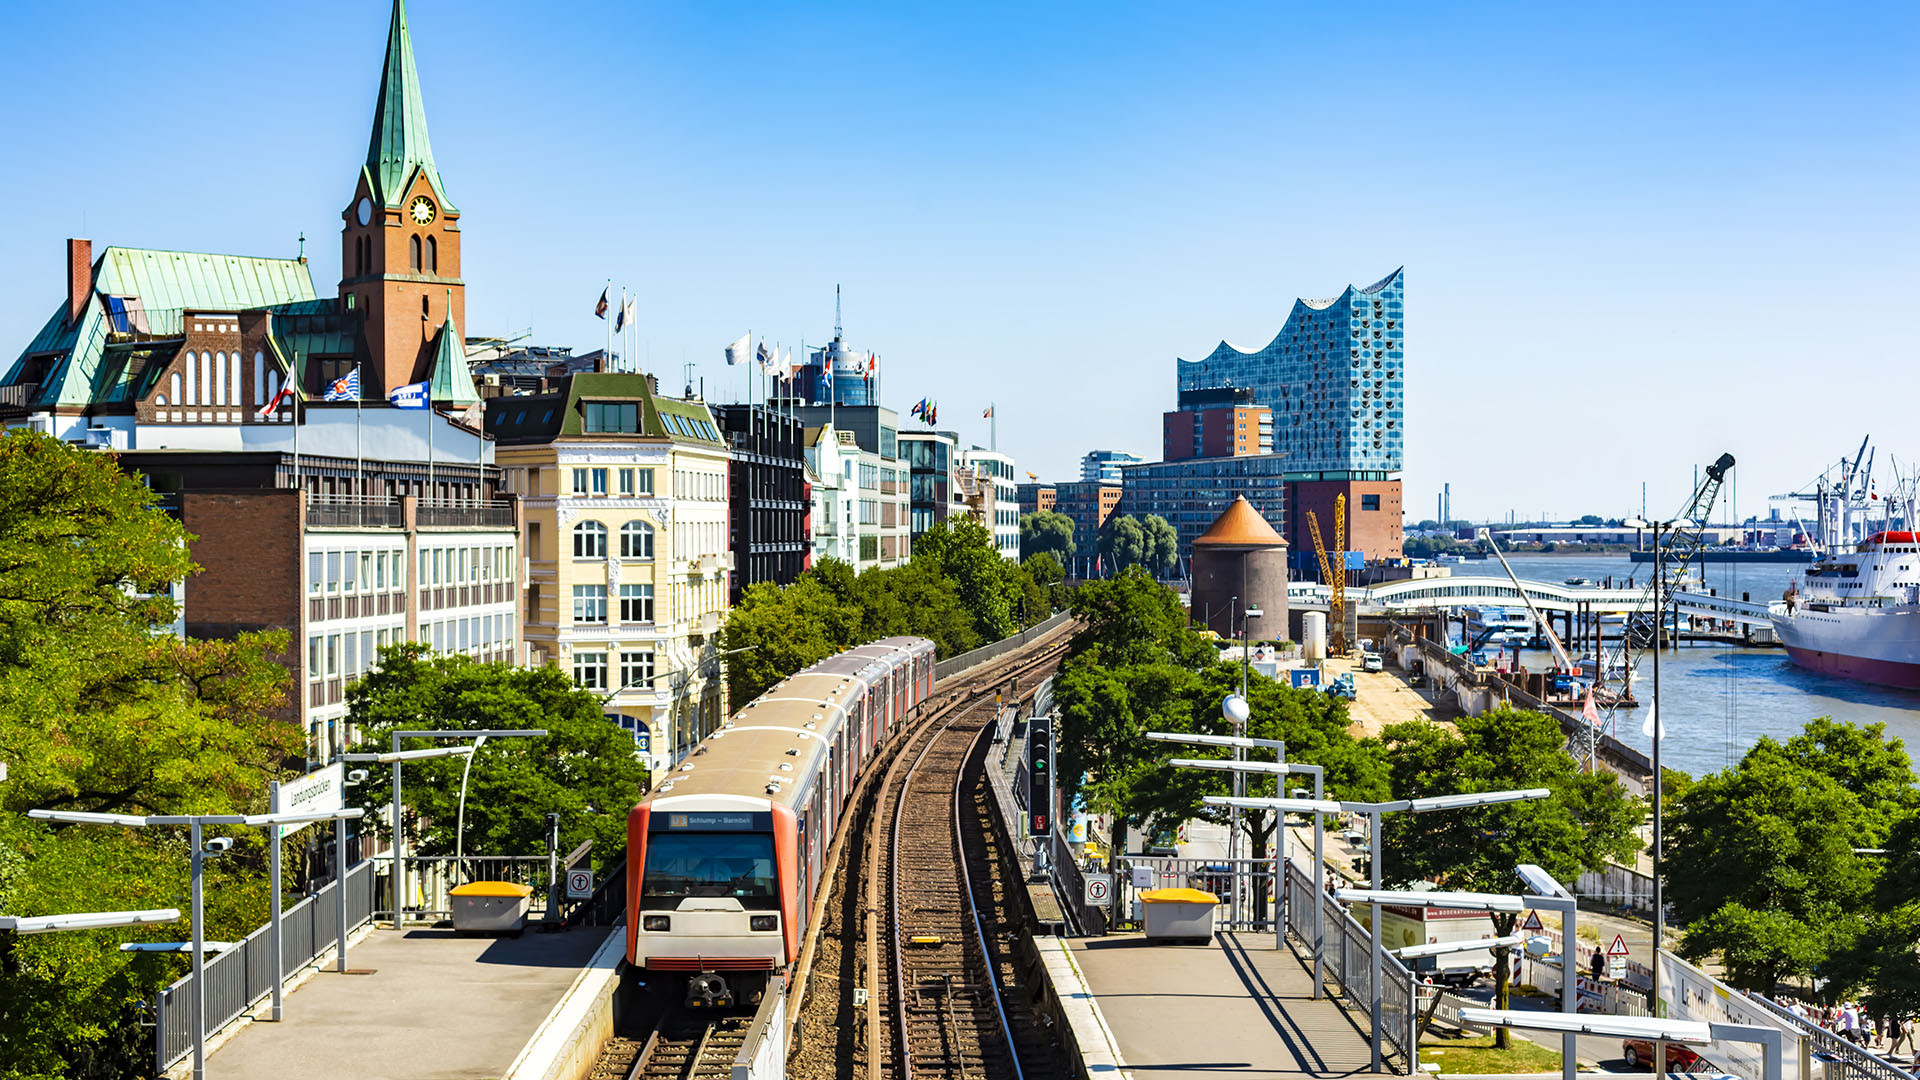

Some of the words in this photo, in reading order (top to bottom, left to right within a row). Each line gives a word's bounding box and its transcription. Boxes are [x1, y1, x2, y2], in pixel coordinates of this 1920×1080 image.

[290, 776, 331, 807] Landungsbrücken
[689, 816, 717, 825] Schlump
[723, 816, 751, 824] Barmbek
[855, 990, 866, 1004] H
